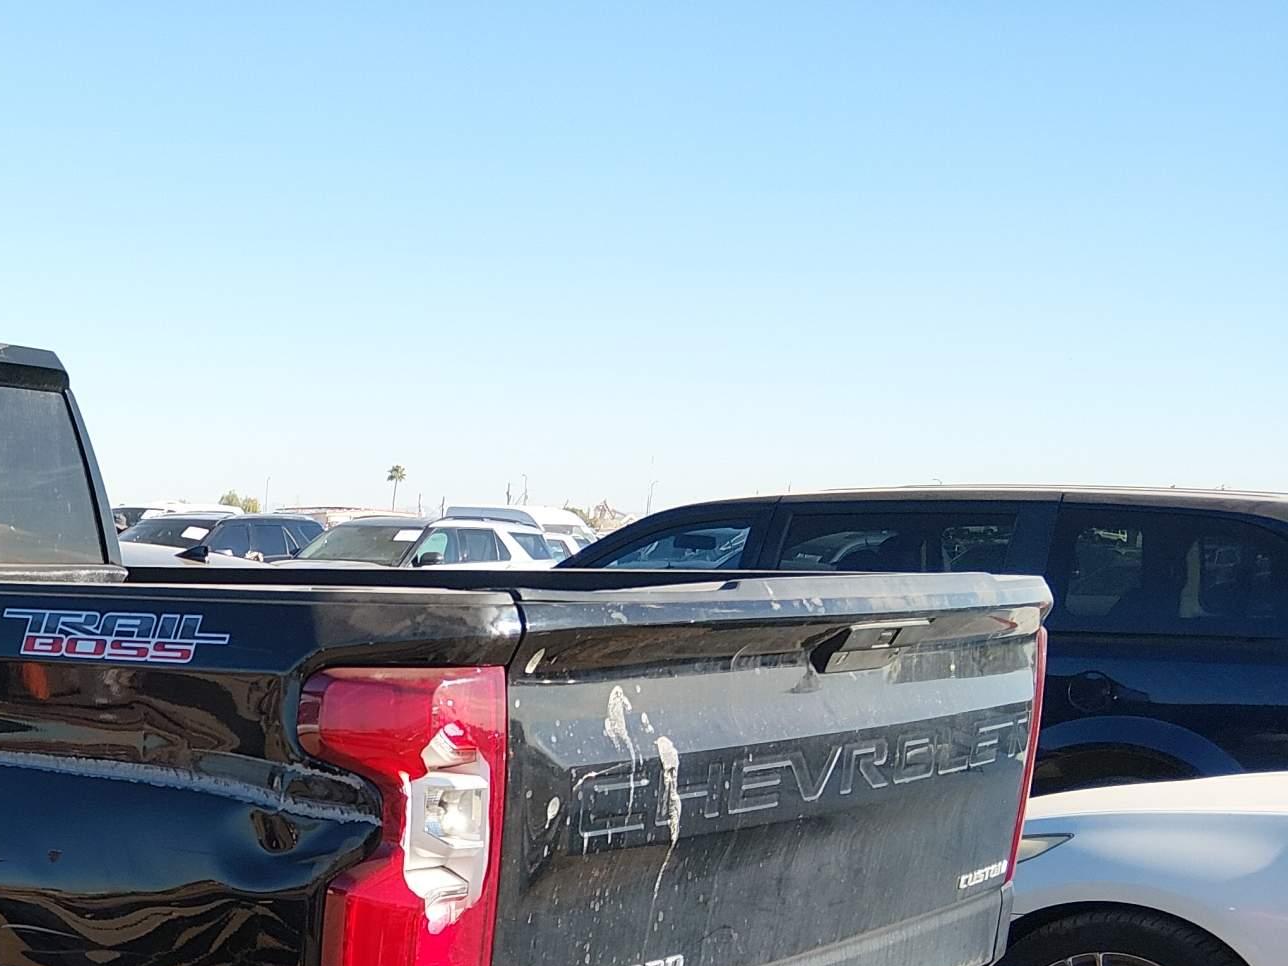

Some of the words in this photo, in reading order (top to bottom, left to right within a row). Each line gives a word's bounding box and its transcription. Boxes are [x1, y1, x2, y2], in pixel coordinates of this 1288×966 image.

[3, 608, 230, 644] TRAIL
[20, 634, 196, 663] BOSS
[578, 713, 1030, 838] CHEVROLET
[958, 859, 1008, 889] CUSTOM
